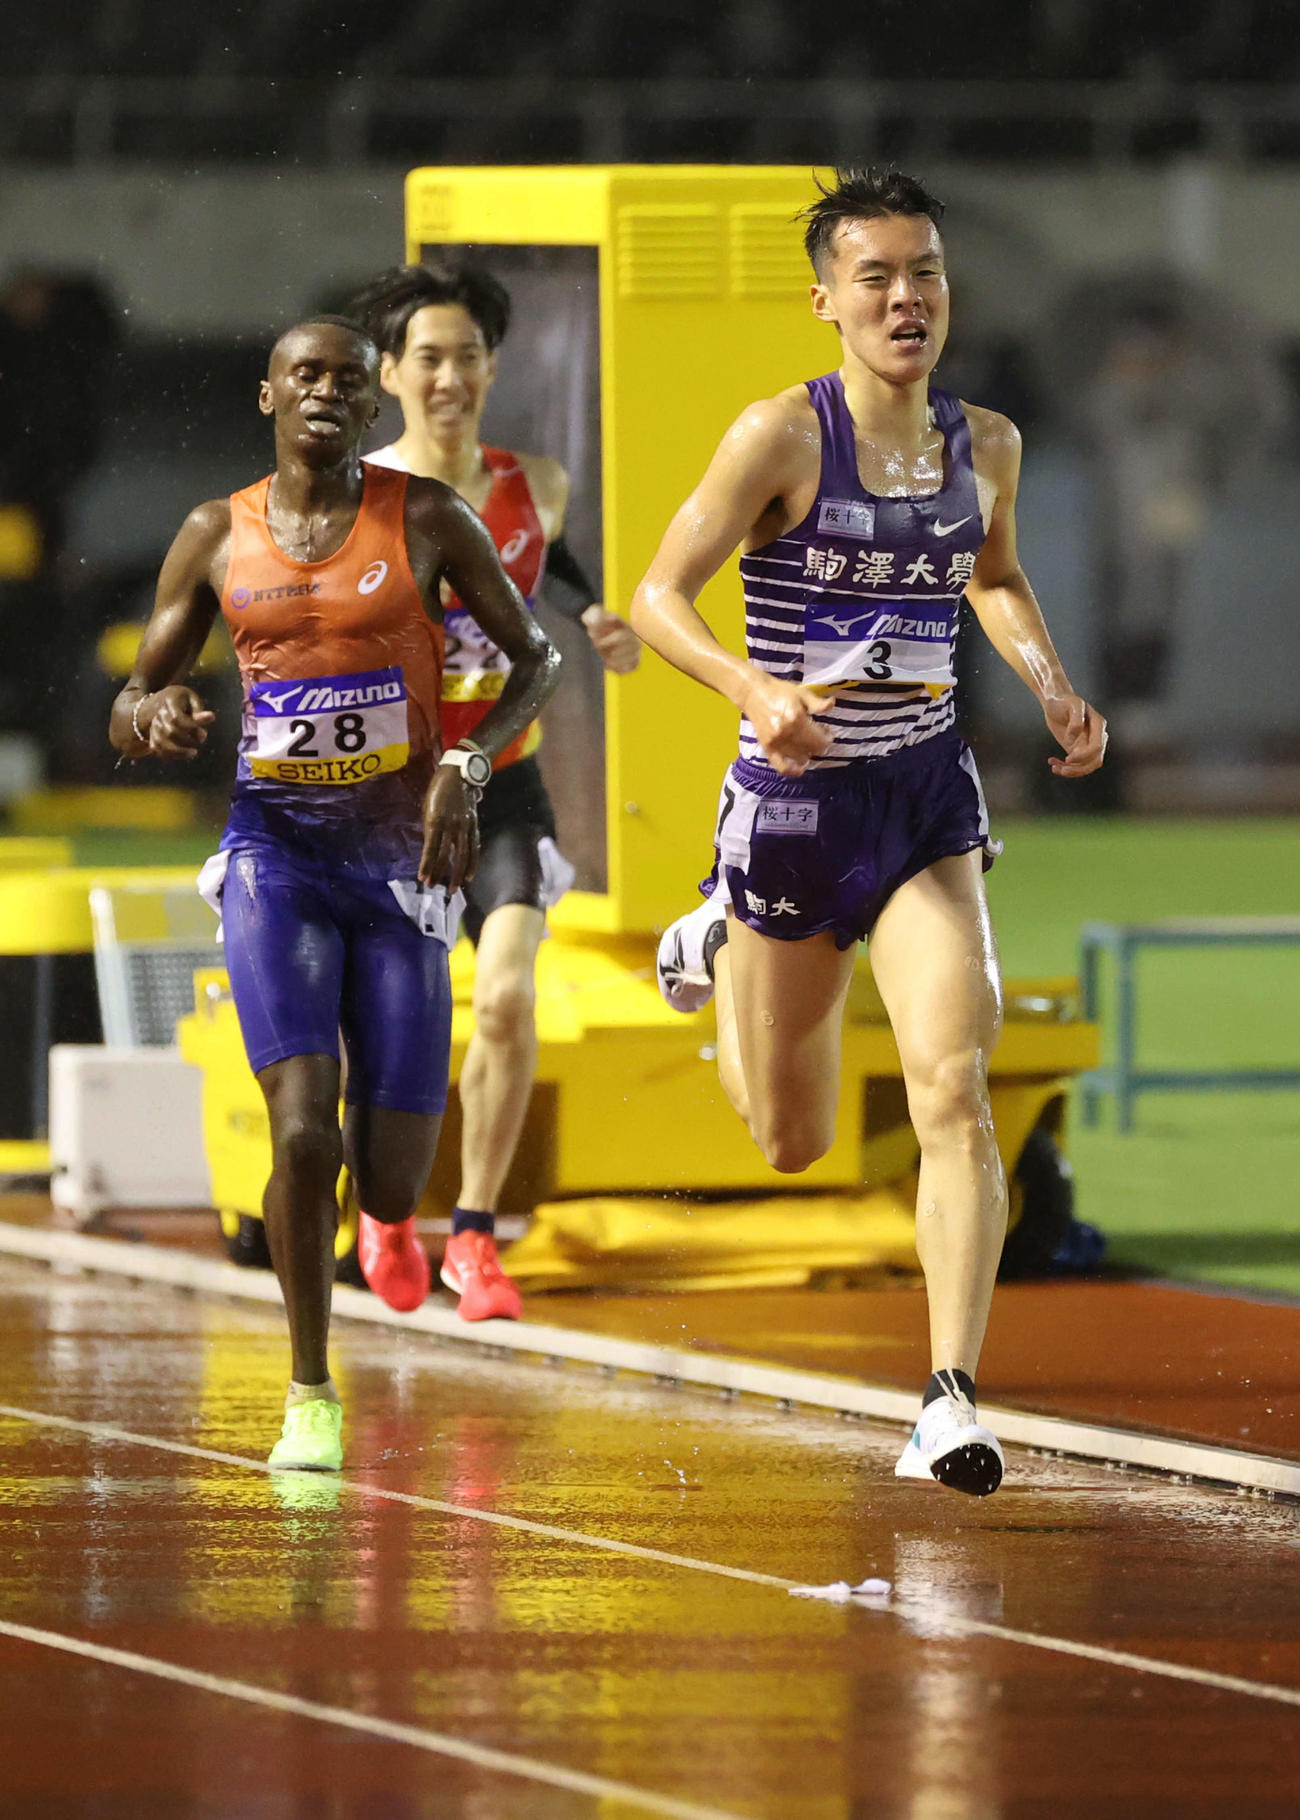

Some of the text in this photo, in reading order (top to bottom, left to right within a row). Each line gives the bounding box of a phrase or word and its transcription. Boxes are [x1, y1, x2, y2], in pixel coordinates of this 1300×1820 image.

[863, 640, 893, 680] 3
[287, 713, 367, 757] 28
[277, 753, 381, 782] SEIKO
[763, 806, 813, 822] 桜十字
[744, 889, 801, 917] 駒大
